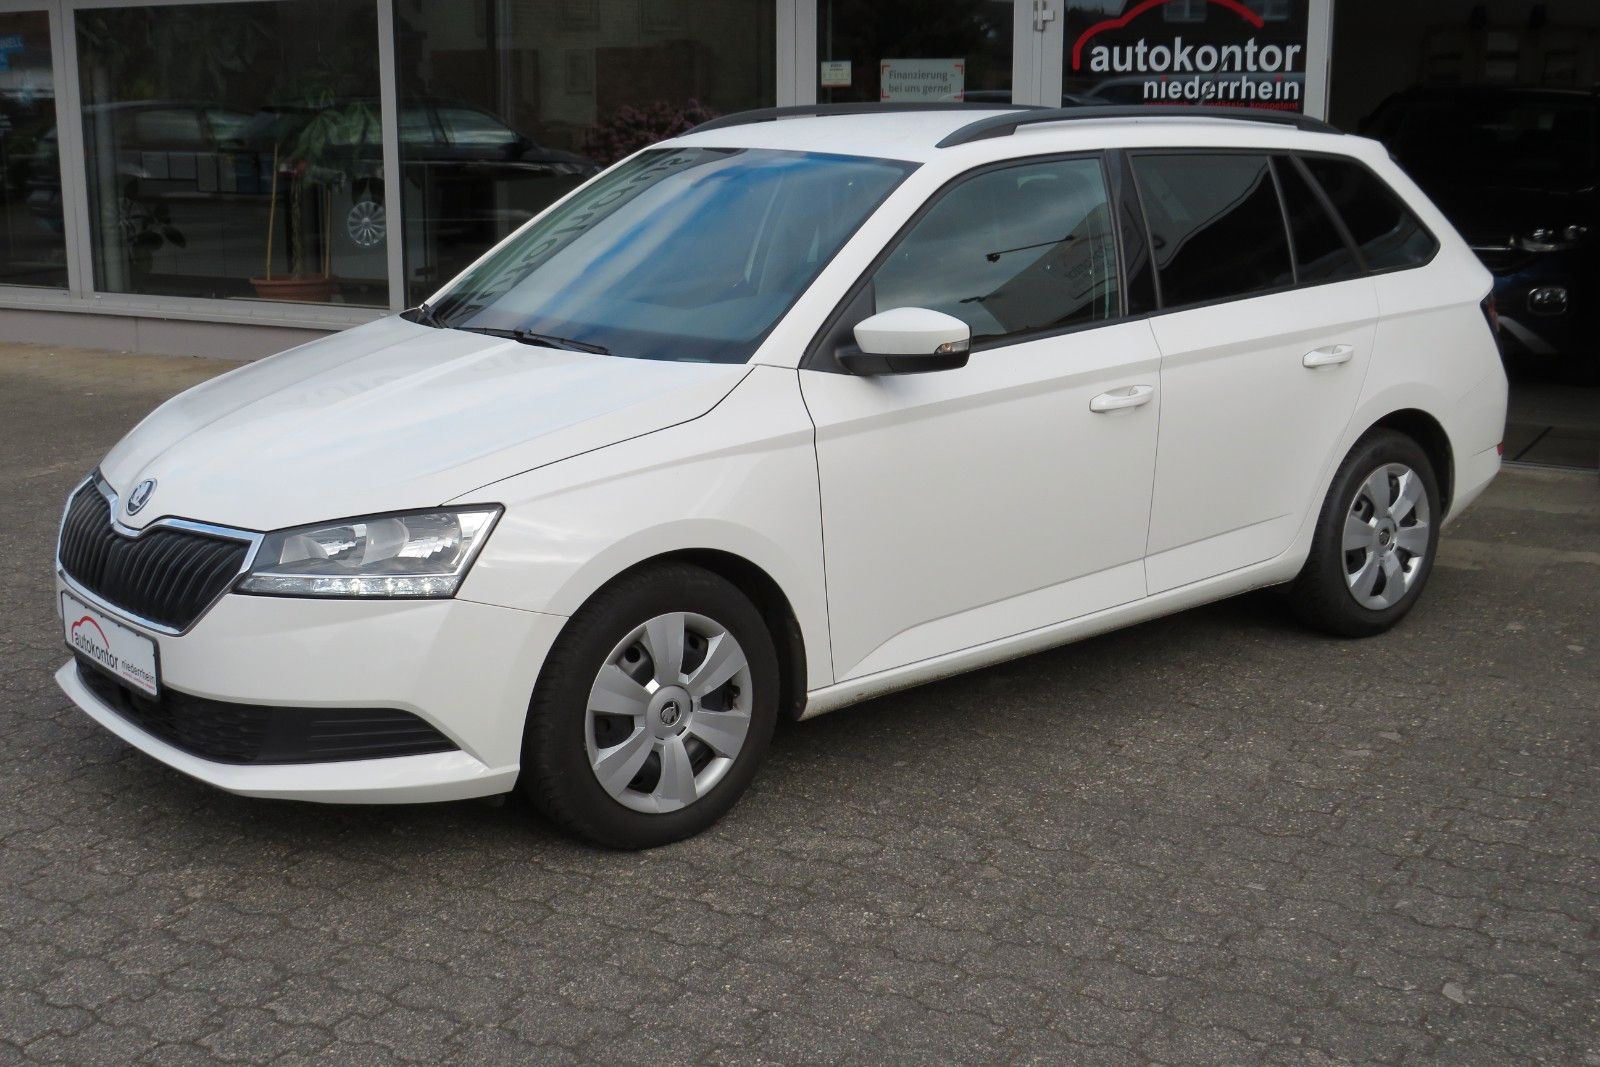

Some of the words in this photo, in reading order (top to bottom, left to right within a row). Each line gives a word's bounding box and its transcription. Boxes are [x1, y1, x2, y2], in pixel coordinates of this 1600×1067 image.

[1090, 36, 1302, 72] autokontor
[888, 70, 949, 81] Finanzierung
[1143, 75, 1299, 100] niederrhein
[888, 83, 903, 93] bei
[904, 85, 922, 93] uns
[922, 84, 952, 96] gerne!
[75, 632, 119, 670] autokontor
[121, 658, 155, 685] niederrhein
